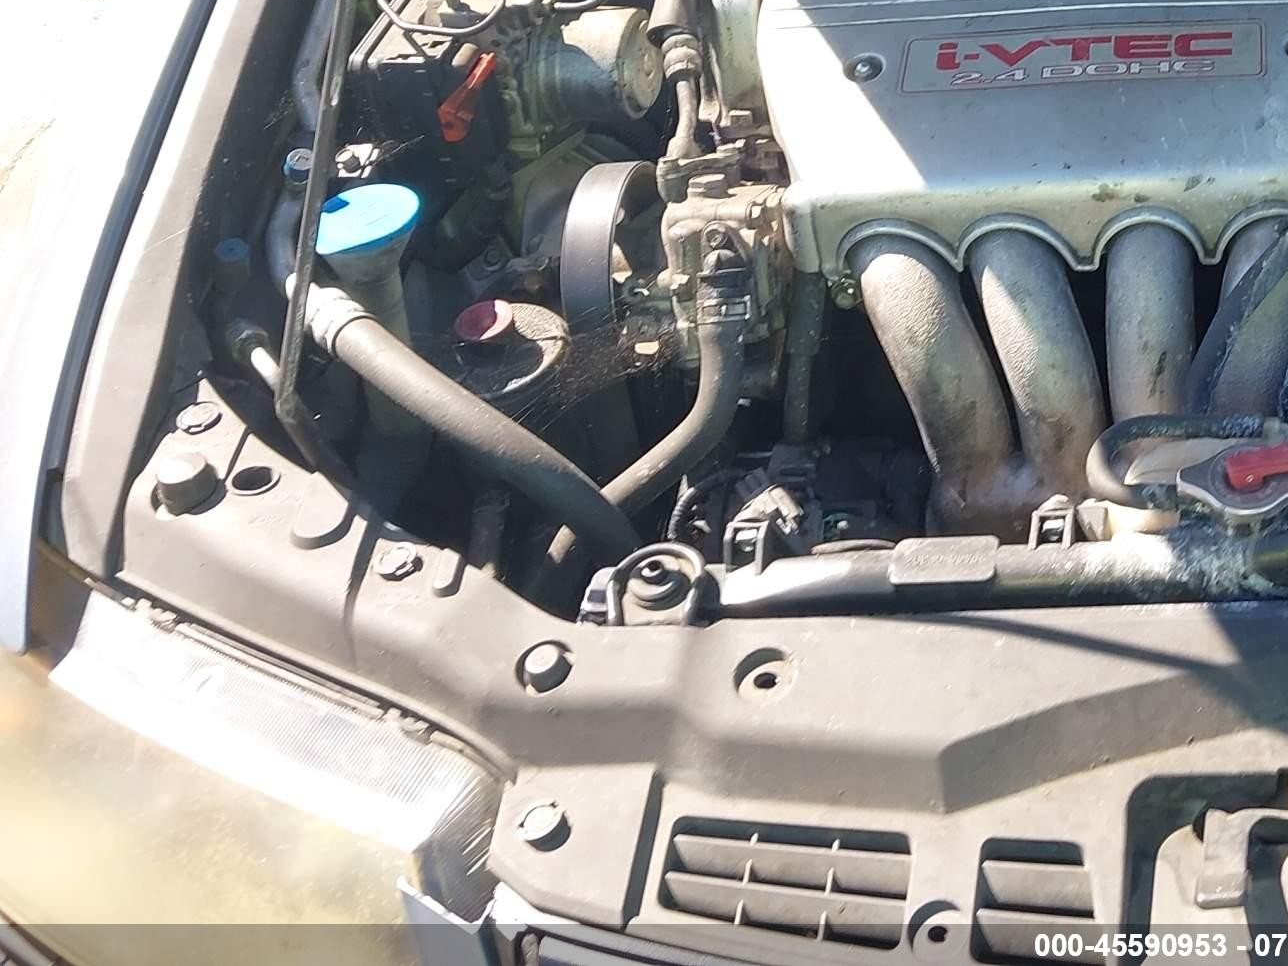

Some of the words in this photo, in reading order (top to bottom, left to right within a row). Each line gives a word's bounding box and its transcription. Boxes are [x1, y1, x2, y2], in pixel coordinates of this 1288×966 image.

[935, 32, 1233, 71] i-VTEC
[950, 67, 1029, 86] 2.4
[1040, 59, 1215, 80] DOHC
